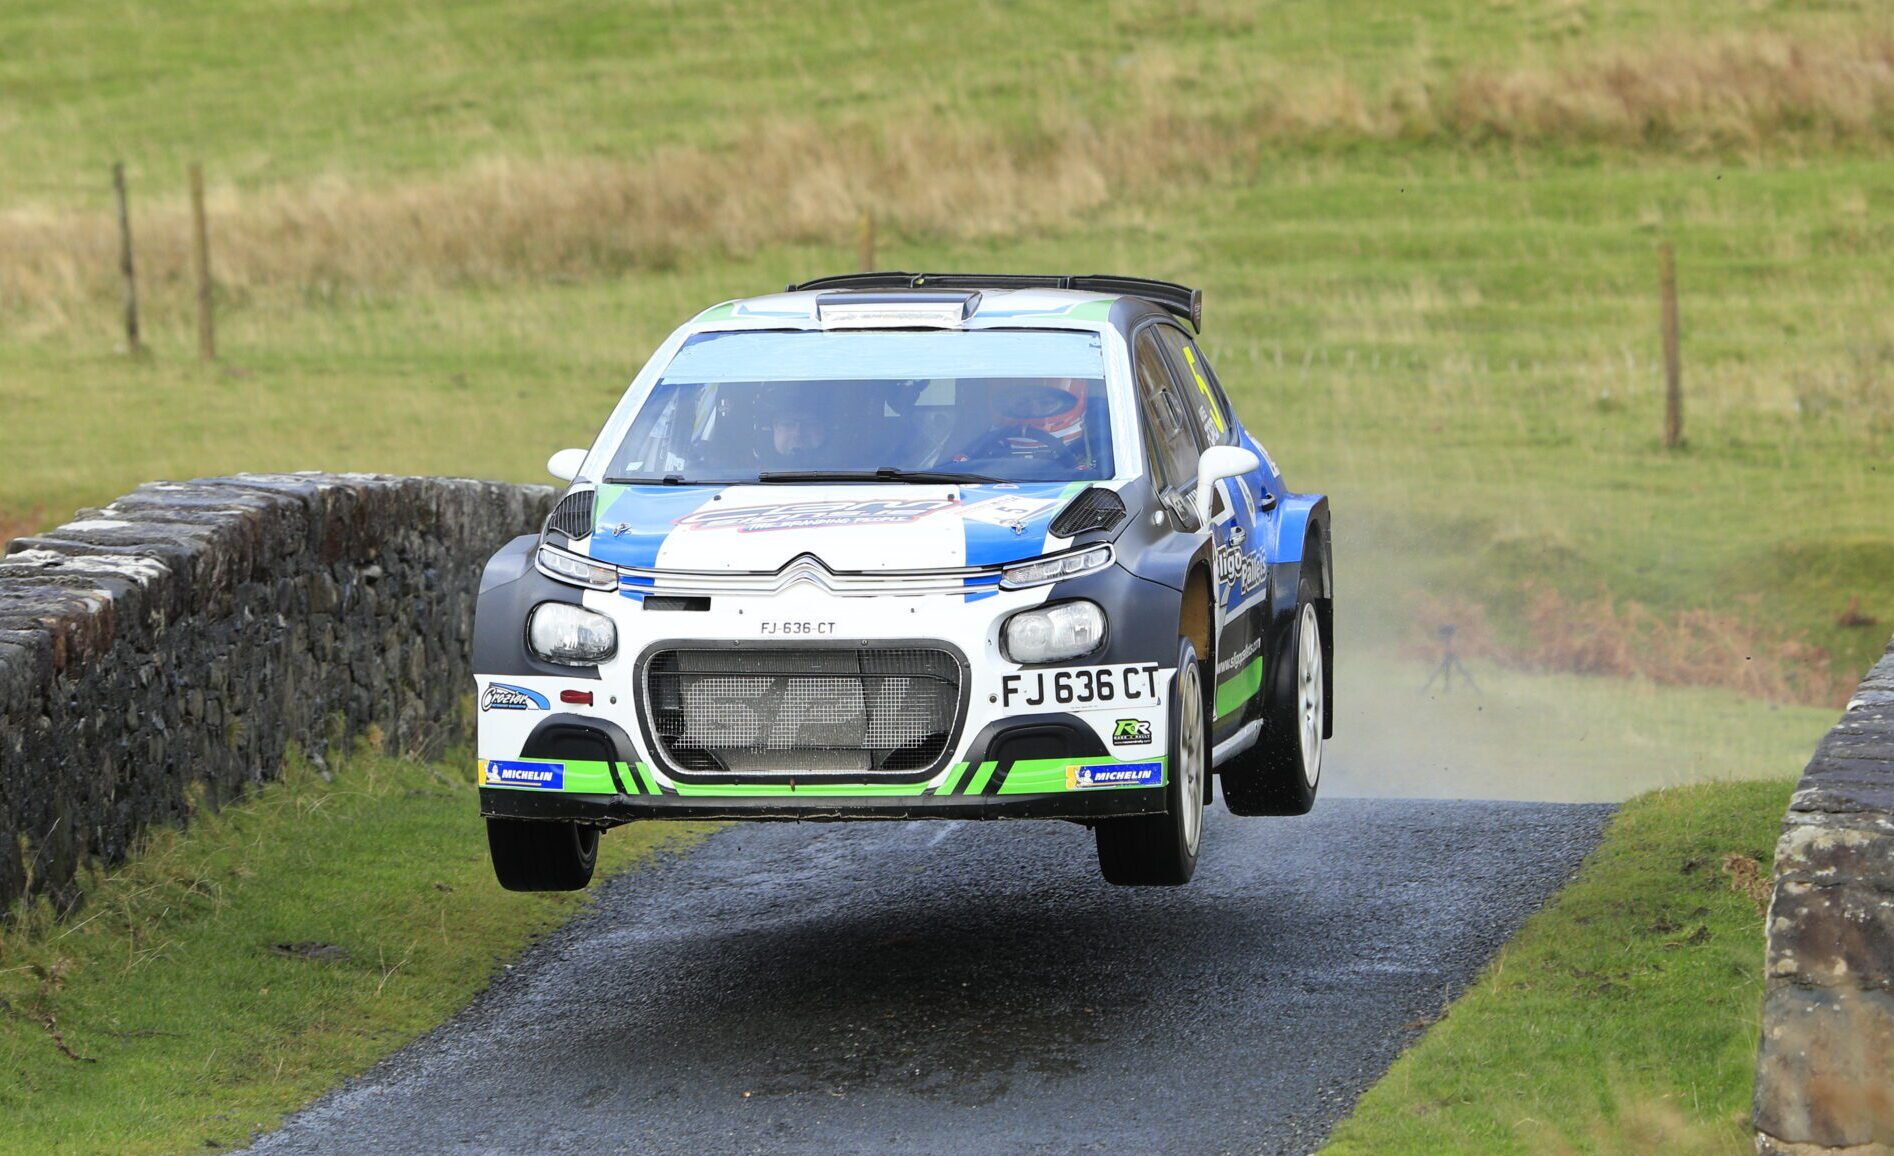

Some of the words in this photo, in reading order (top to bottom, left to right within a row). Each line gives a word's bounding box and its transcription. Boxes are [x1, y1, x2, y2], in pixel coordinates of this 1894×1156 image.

[1242, 550, 1267, 588] Pallets
[760, 621, 836, 635] FJ-636-CT
[1002, 673, 1044, 708] FJ
[1054, 670, 1114, 704] 636
[1123, 666, 1159, 700] CT
[501, 768, 554, 783] MICHELIN
[1094, 769, 1152, 782] MICHELIN
